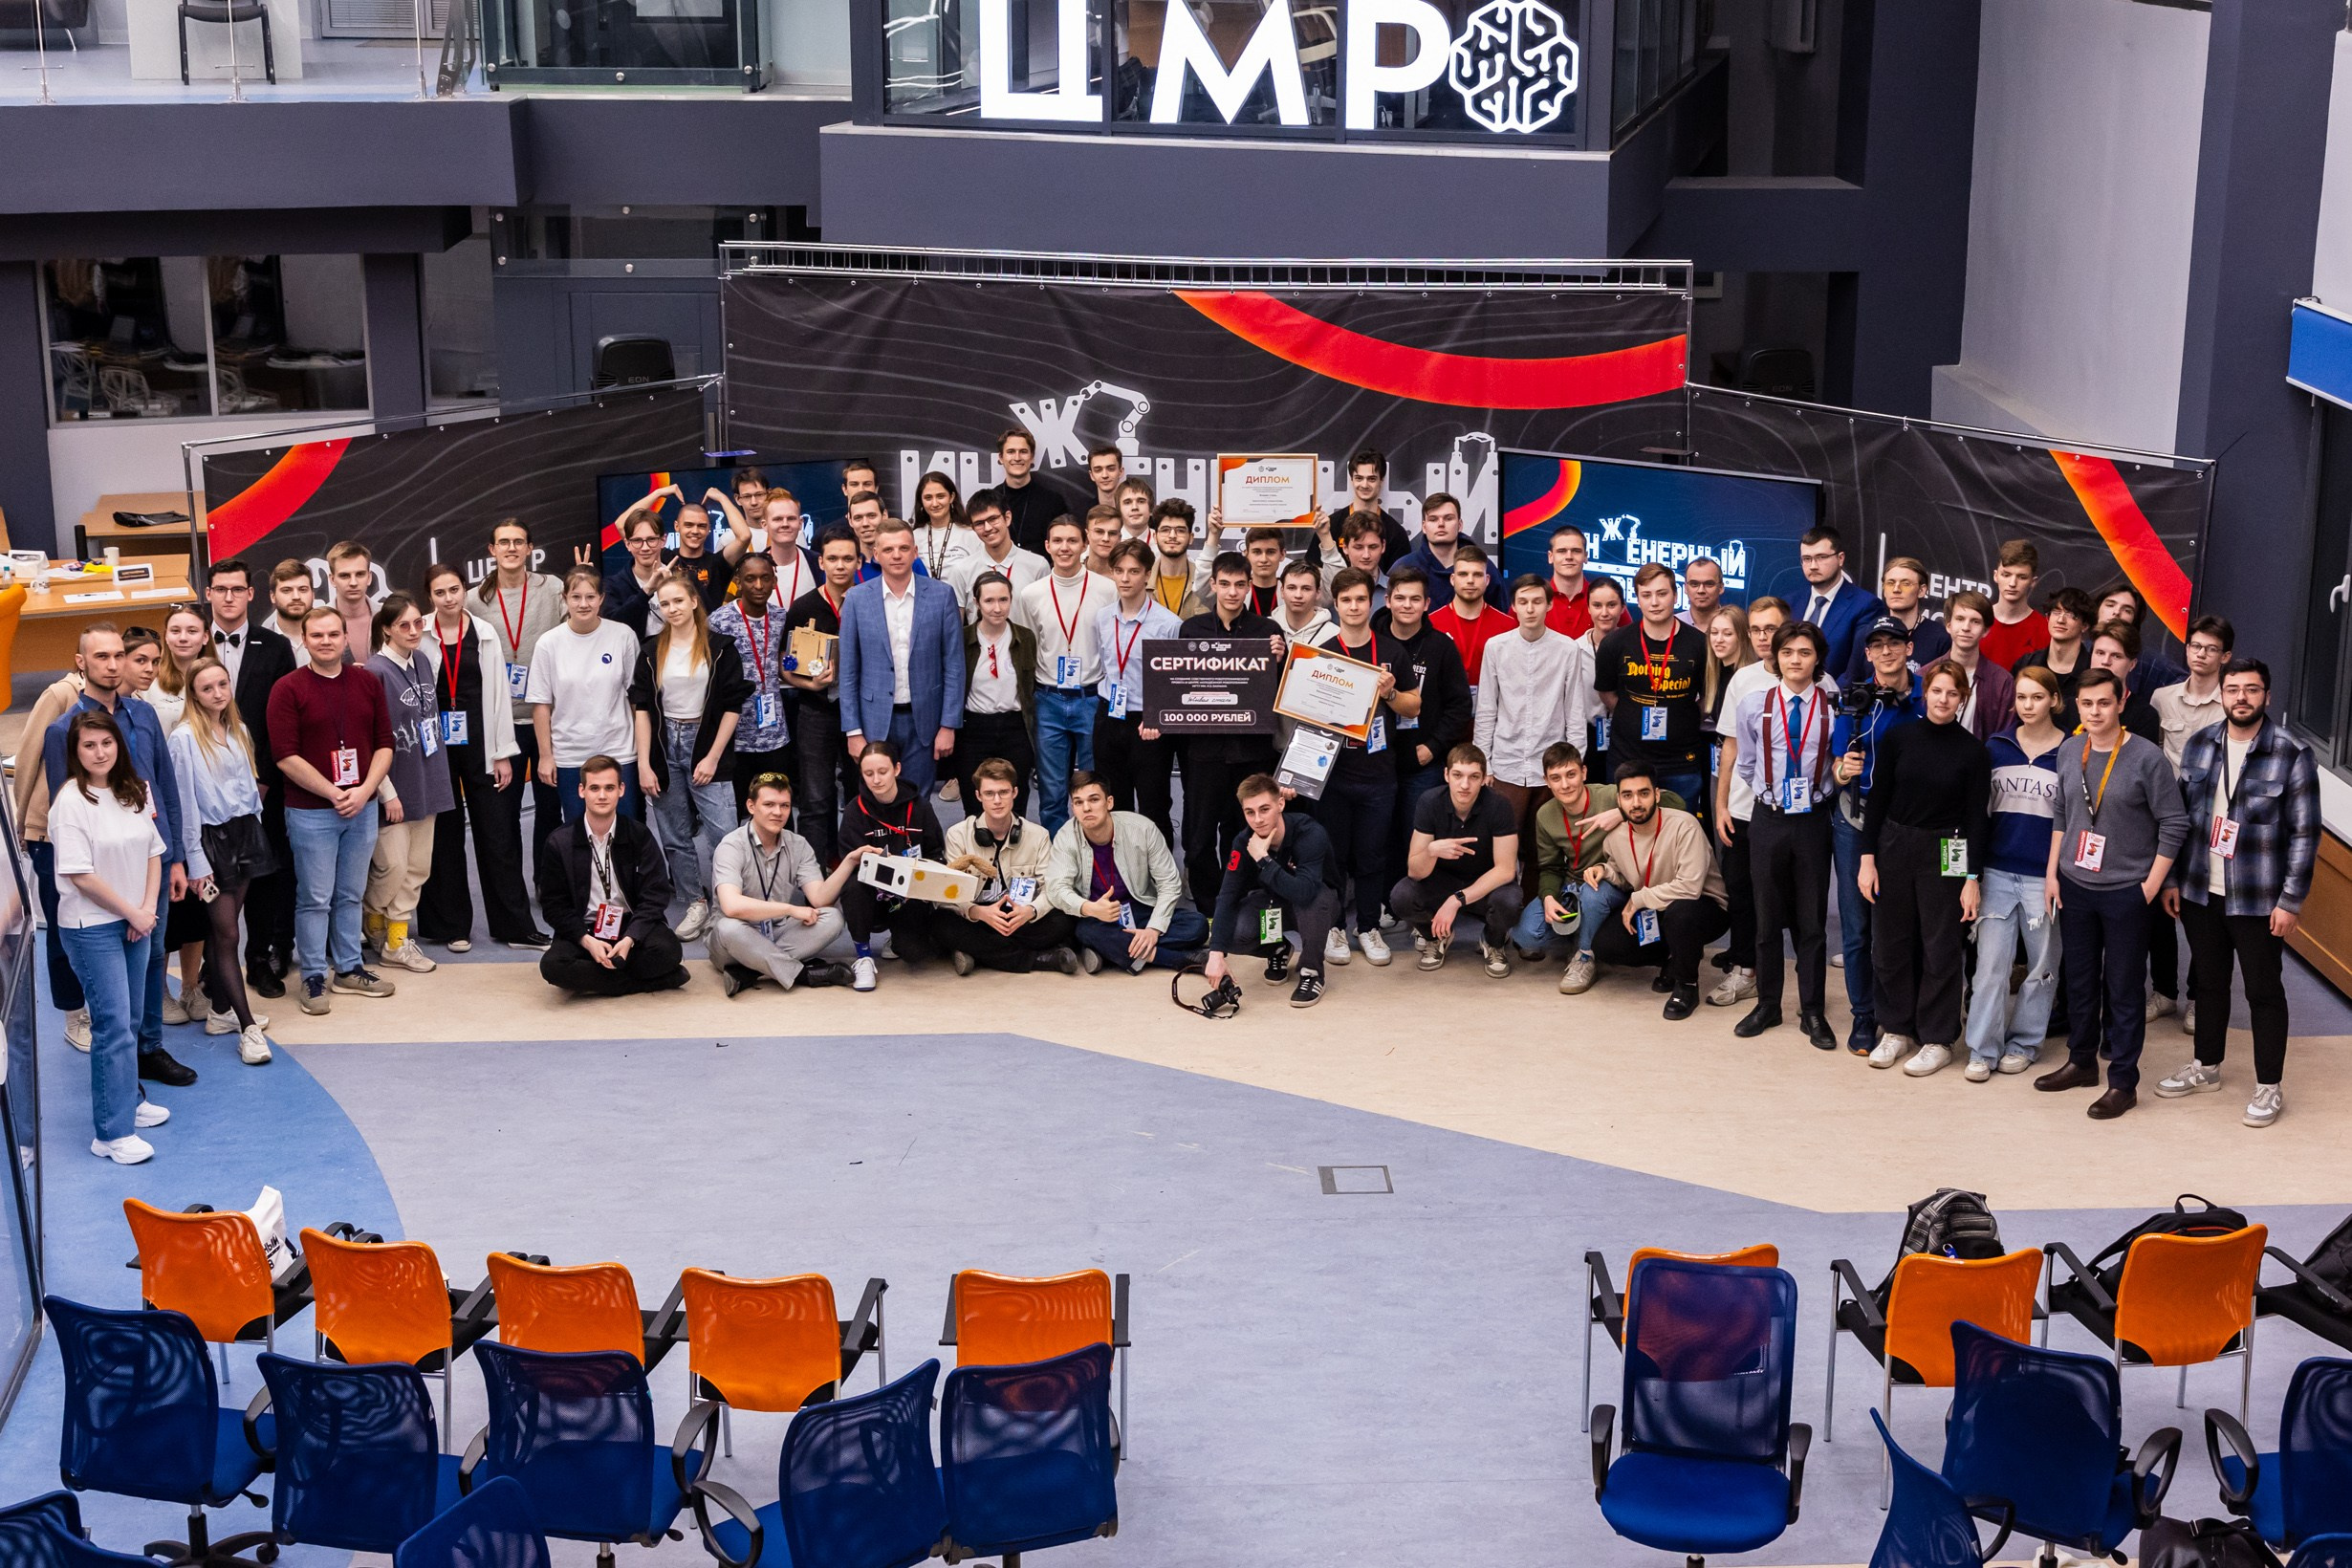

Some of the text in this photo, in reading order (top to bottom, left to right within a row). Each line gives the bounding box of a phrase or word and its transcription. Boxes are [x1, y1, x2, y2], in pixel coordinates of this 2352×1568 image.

[1245, 475, 1290, 484] ДИПЛОМ
[1924, 573, 1993, 599] ЕНТР
[1150, 656, 1270, 671] СЕРТИФИКАТ
[1312, 669, 1354, 689] ДИПЛОМ
[1164, 711, 1252, 722] 100 000 РУБЛЕЙ
[1228, 850, 1241, 871] 3
